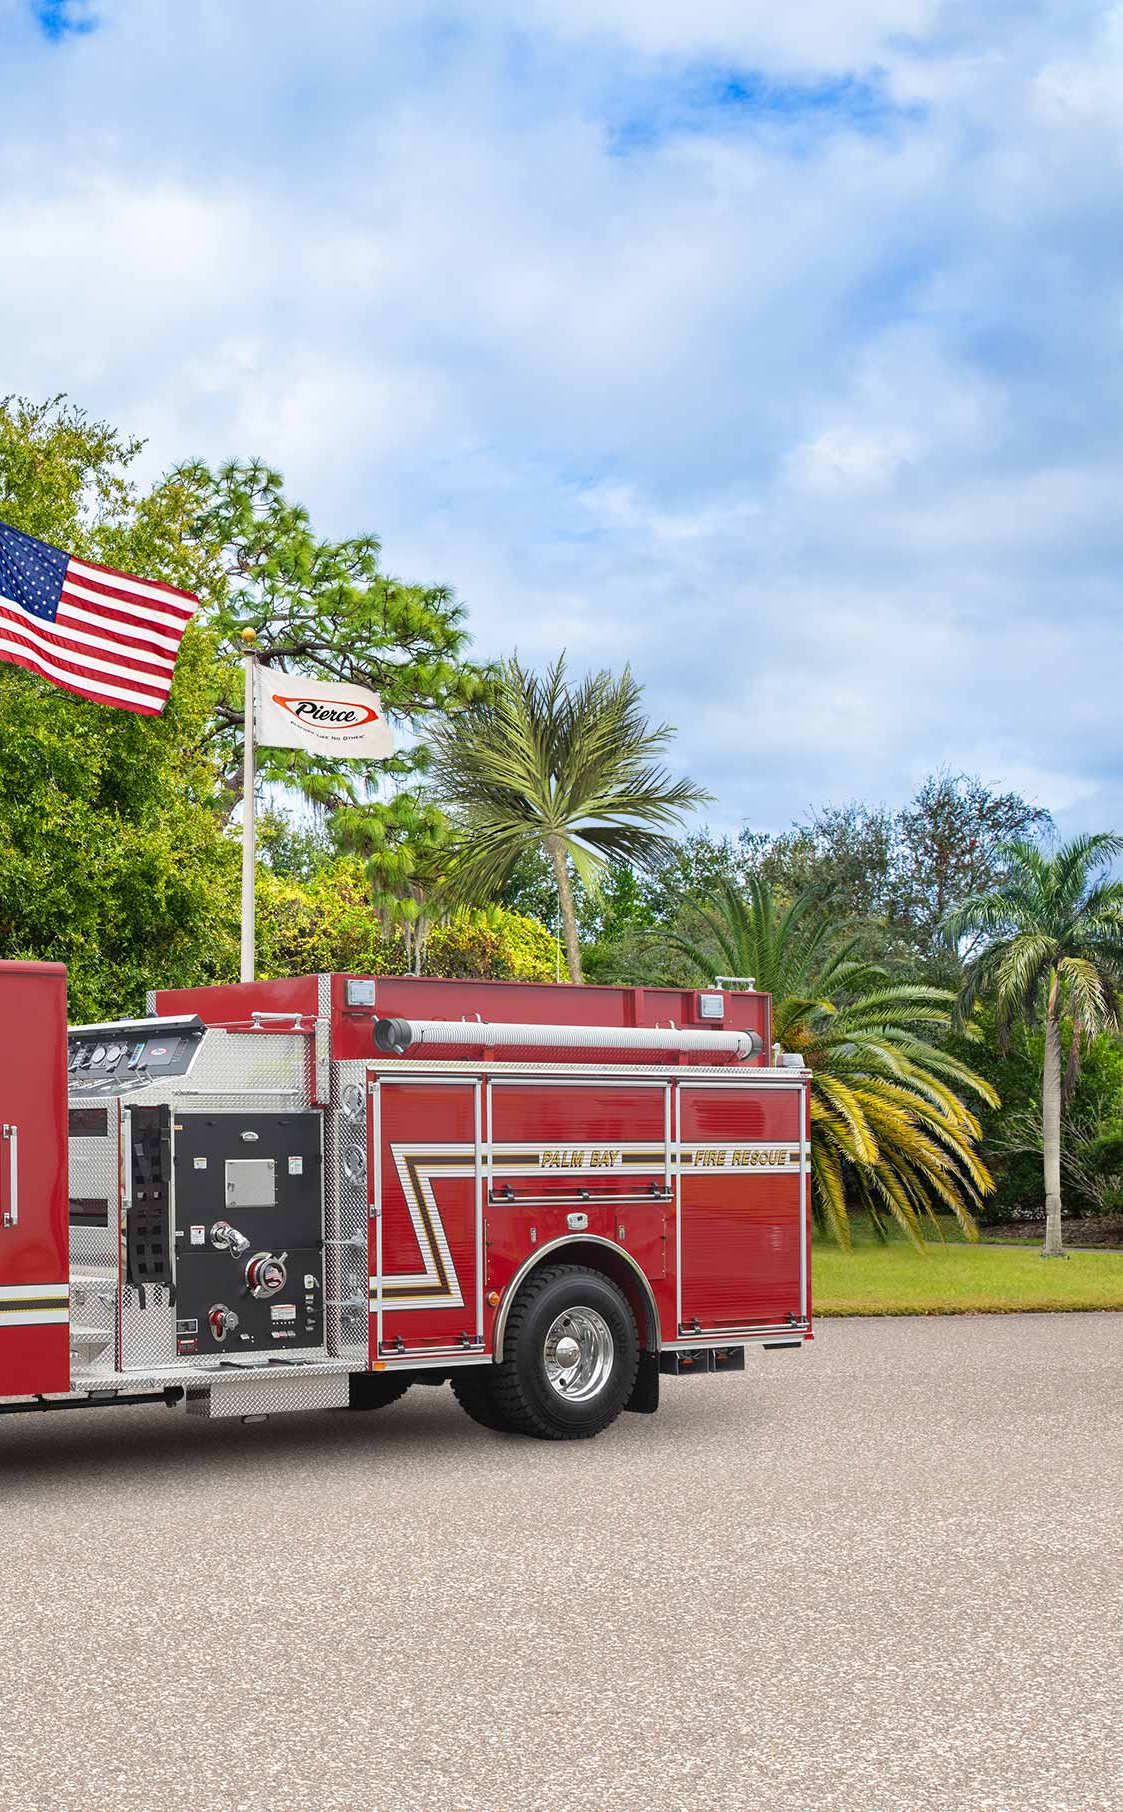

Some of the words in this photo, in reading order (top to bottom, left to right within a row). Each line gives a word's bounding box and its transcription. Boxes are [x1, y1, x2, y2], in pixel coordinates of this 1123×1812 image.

[295, 701, 356, 722] Pierce
[541, 1150, 585, 1168] PALM
[590, 1150, 620, 1168] BAY
[694, 1150, 727, 1167] FIRE
[732, 1149, 788, 1167] RESCUE
